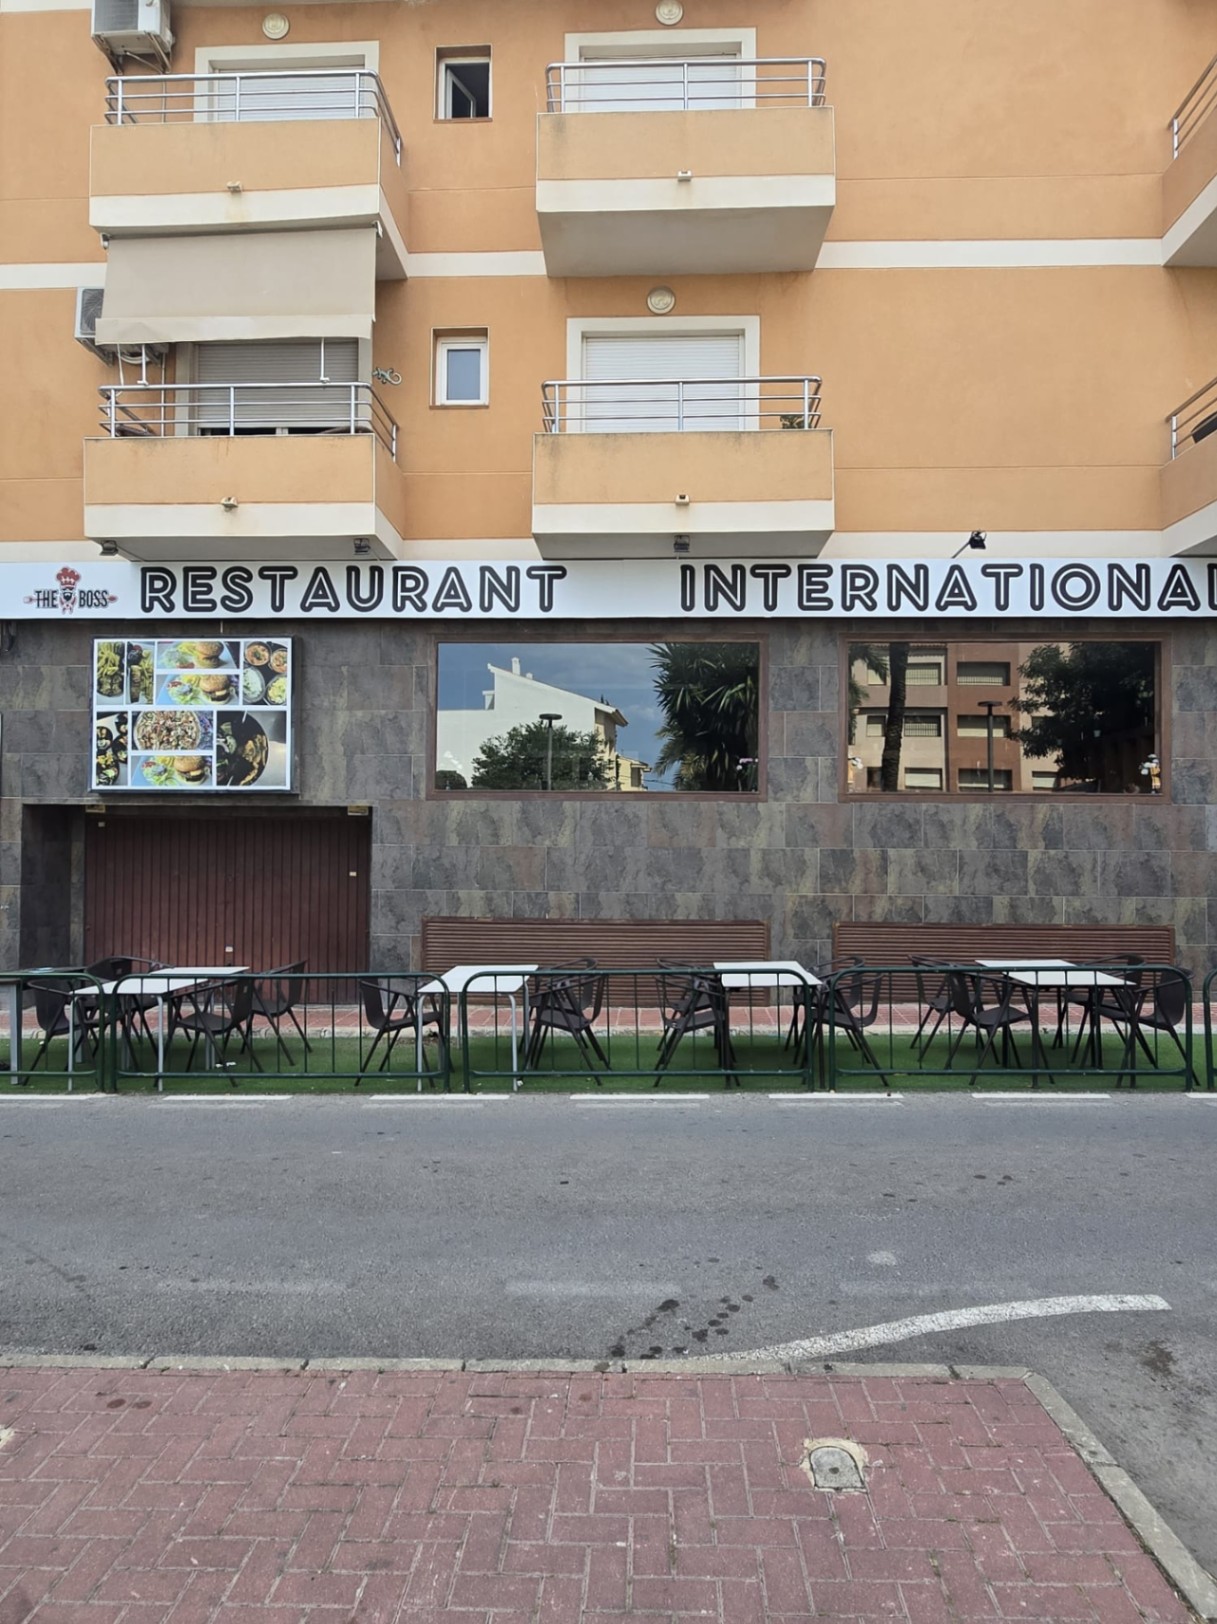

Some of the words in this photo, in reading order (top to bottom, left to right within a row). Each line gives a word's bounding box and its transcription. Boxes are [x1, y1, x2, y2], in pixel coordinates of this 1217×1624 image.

[35, 590, 58, 608] THE
[79, 590, 108, 608] BOSS
[140, 565, 568, 613] RESTAURANT
